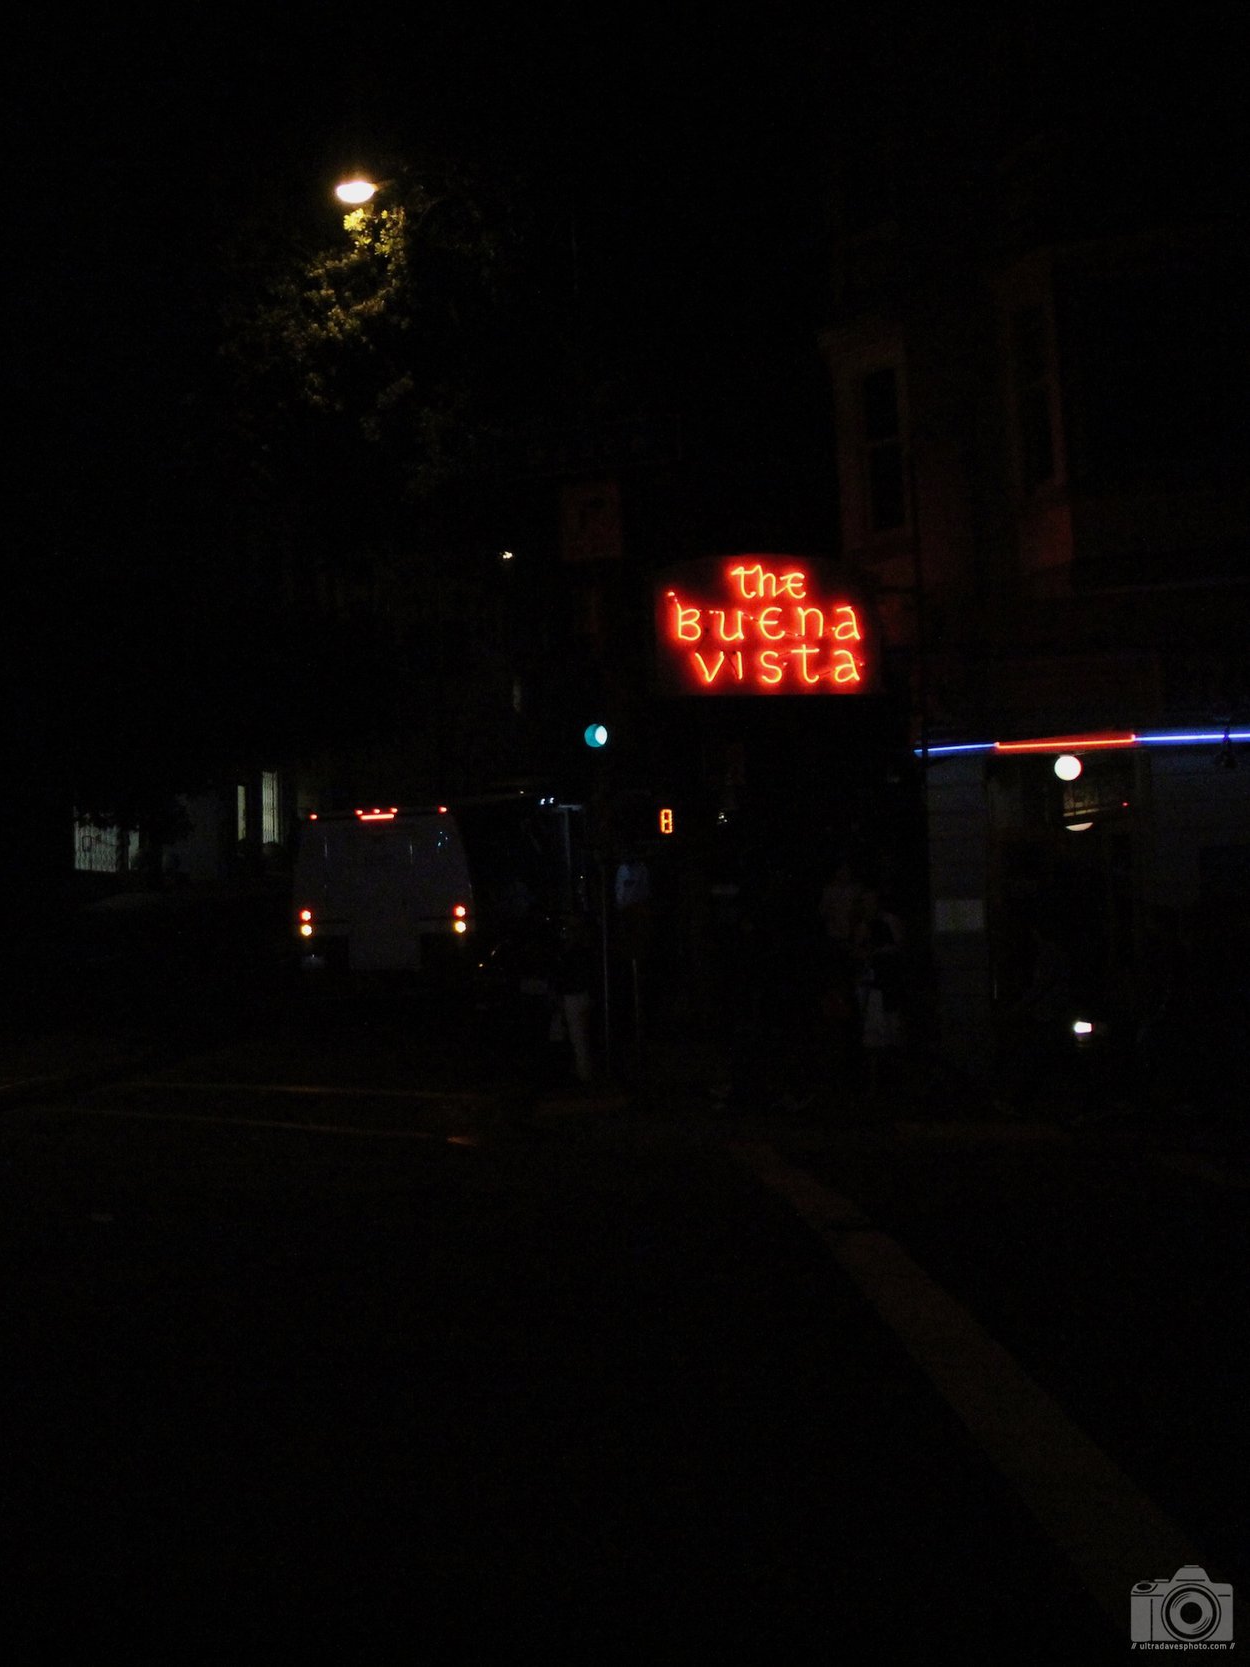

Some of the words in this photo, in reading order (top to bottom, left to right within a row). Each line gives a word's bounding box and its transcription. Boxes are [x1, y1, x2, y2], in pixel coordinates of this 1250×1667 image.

[731, 565, 806, 598] the
[695, 644, 861, 683] vista
[660, 808, 673, 834] 8
